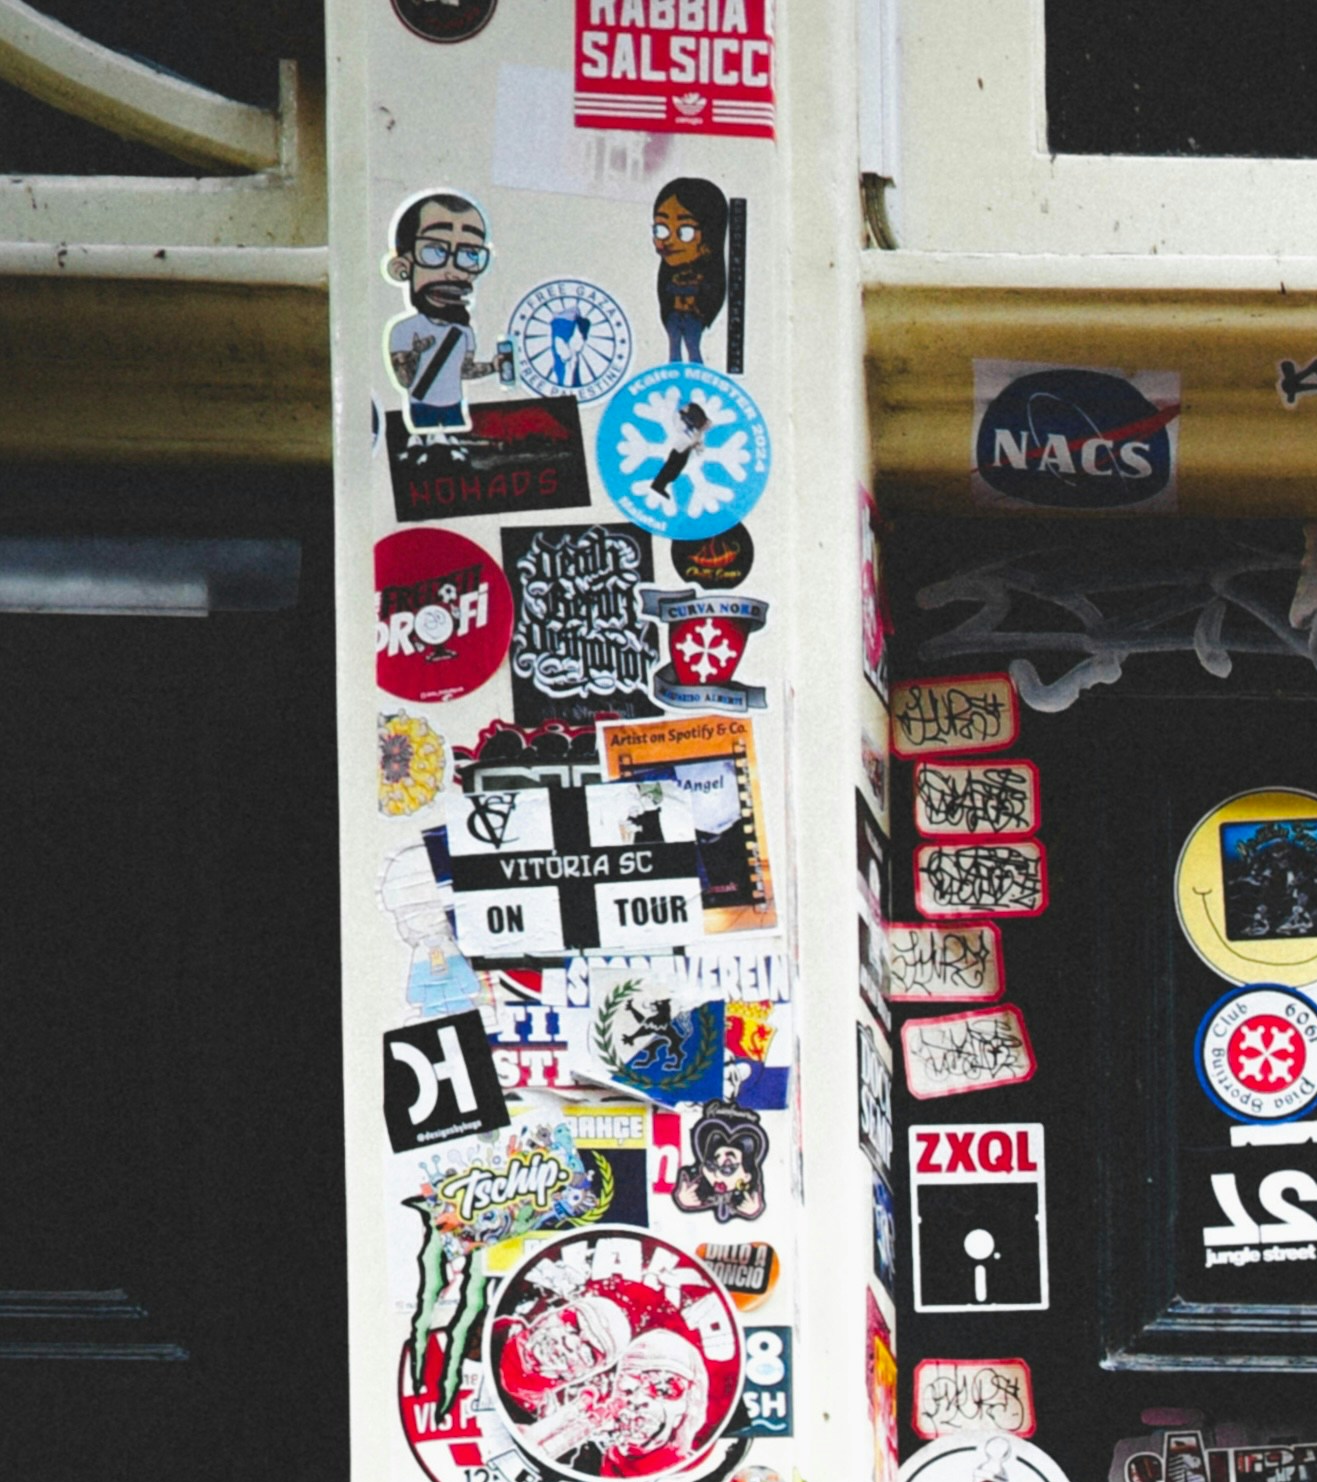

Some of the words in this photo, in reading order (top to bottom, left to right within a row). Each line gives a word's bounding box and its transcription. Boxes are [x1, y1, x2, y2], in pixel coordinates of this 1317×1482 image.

[994, 428, 1155, 479] NACS
[409, 470, 558, 504] NOMADS
[668, 603, 718, 619] CURVA
[721, 600, 763, 618] NORD
[610, 729, 648, 747] Artist
[650, 730, 665, 744] on
[668, 724, 718, 743] Spotify
[719, 723, 728, 736] &
[730, 722, 747, 736] Co.
[500, 851, 610, 881] VITÓRIA
[618, 851, 653, 874] SC
[487, 905, 523, 934] ON
[614, 897, 689, 927] TOUR
[916, 1131, 1038, 1175] ZXQL
[1205, 1244, 1260, 1267] jungle
[1262, 1243, 1315, 1263] street
